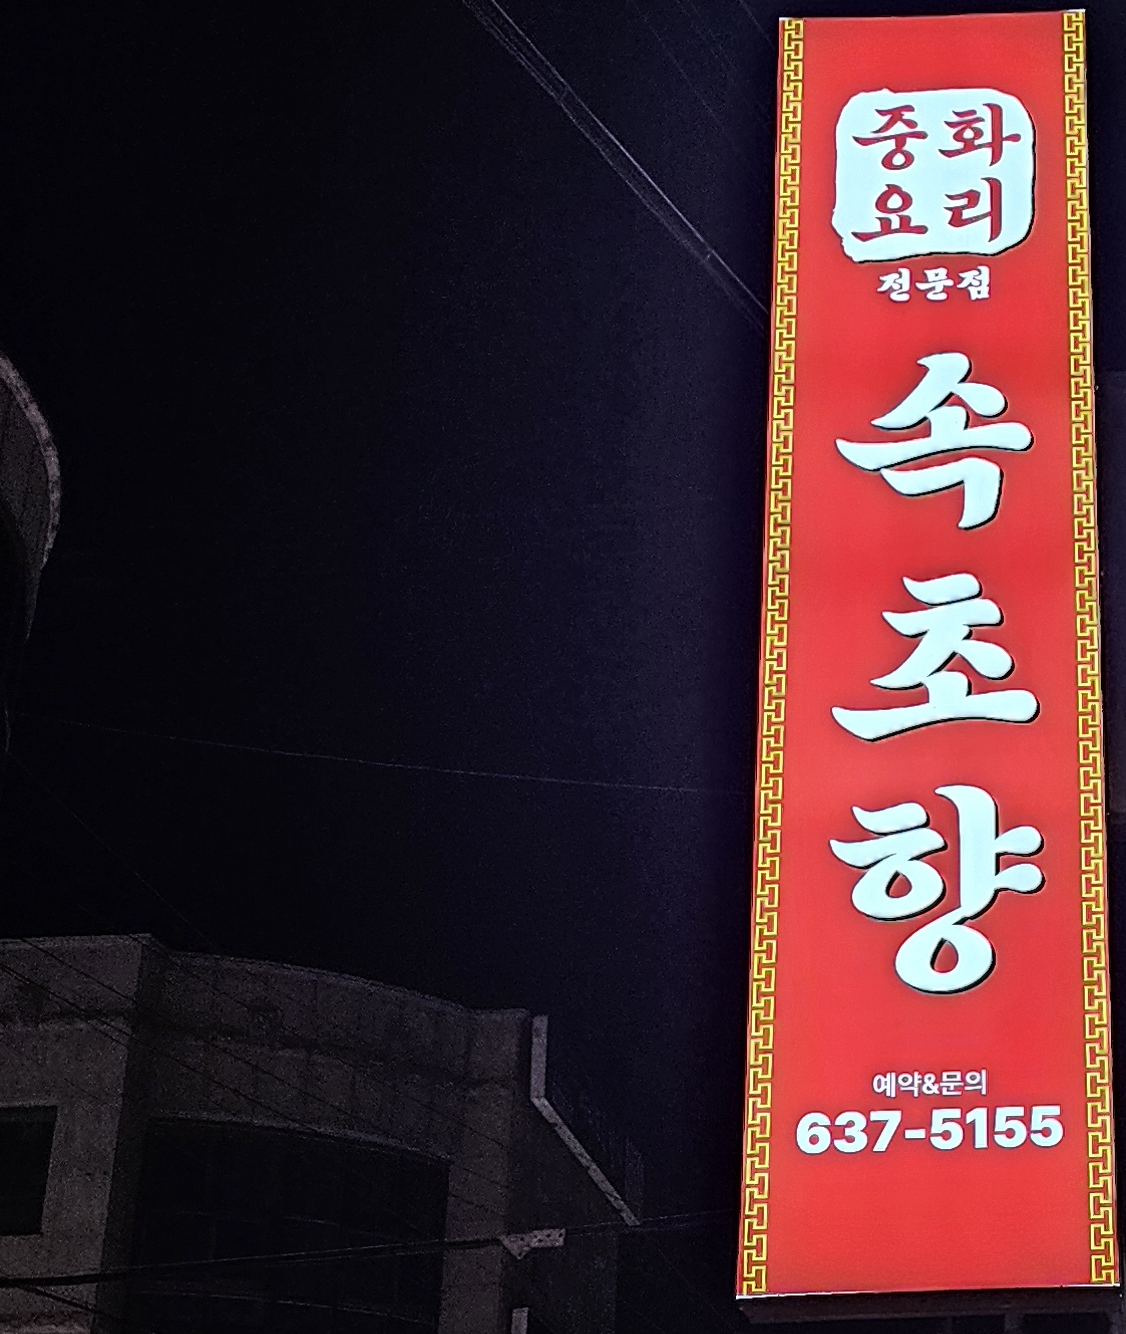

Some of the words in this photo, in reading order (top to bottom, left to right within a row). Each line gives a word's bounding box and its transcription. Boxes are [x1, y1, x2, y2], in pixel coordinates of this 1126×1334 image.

[852, 102, 1022, 171] 중화
[851, 177, 1003, 243] 요리
[876, 265, 992, 302] 전문점
[829, 351, 1046, 996] 속초향
[872, 1069, 987, 1098] 예약&문의
[796, 1104, 1064, 1155] 637-5155
